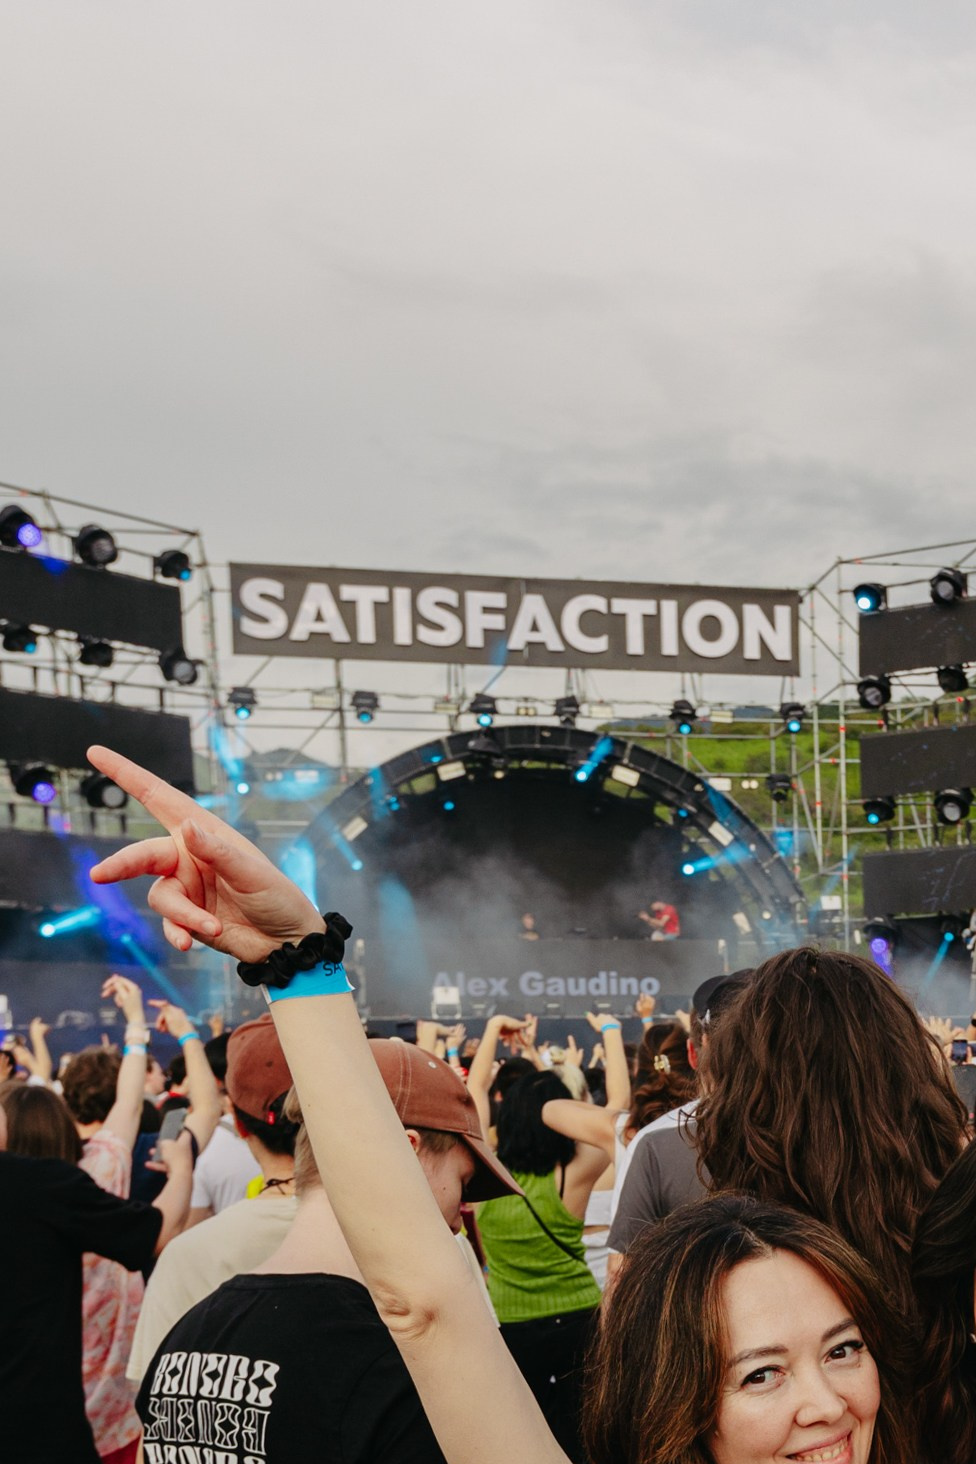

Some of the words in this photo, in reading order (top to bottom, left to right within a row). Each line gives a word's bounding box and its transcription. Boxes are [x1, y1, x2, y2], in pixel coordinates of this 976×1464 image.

[239, 577, 793, 662] SATISFACTION
[433, 971, 510, 997] Alex
[518, 970, 661, 997] Gaudino
[150, 1351, 280, 1407] BONOBO
